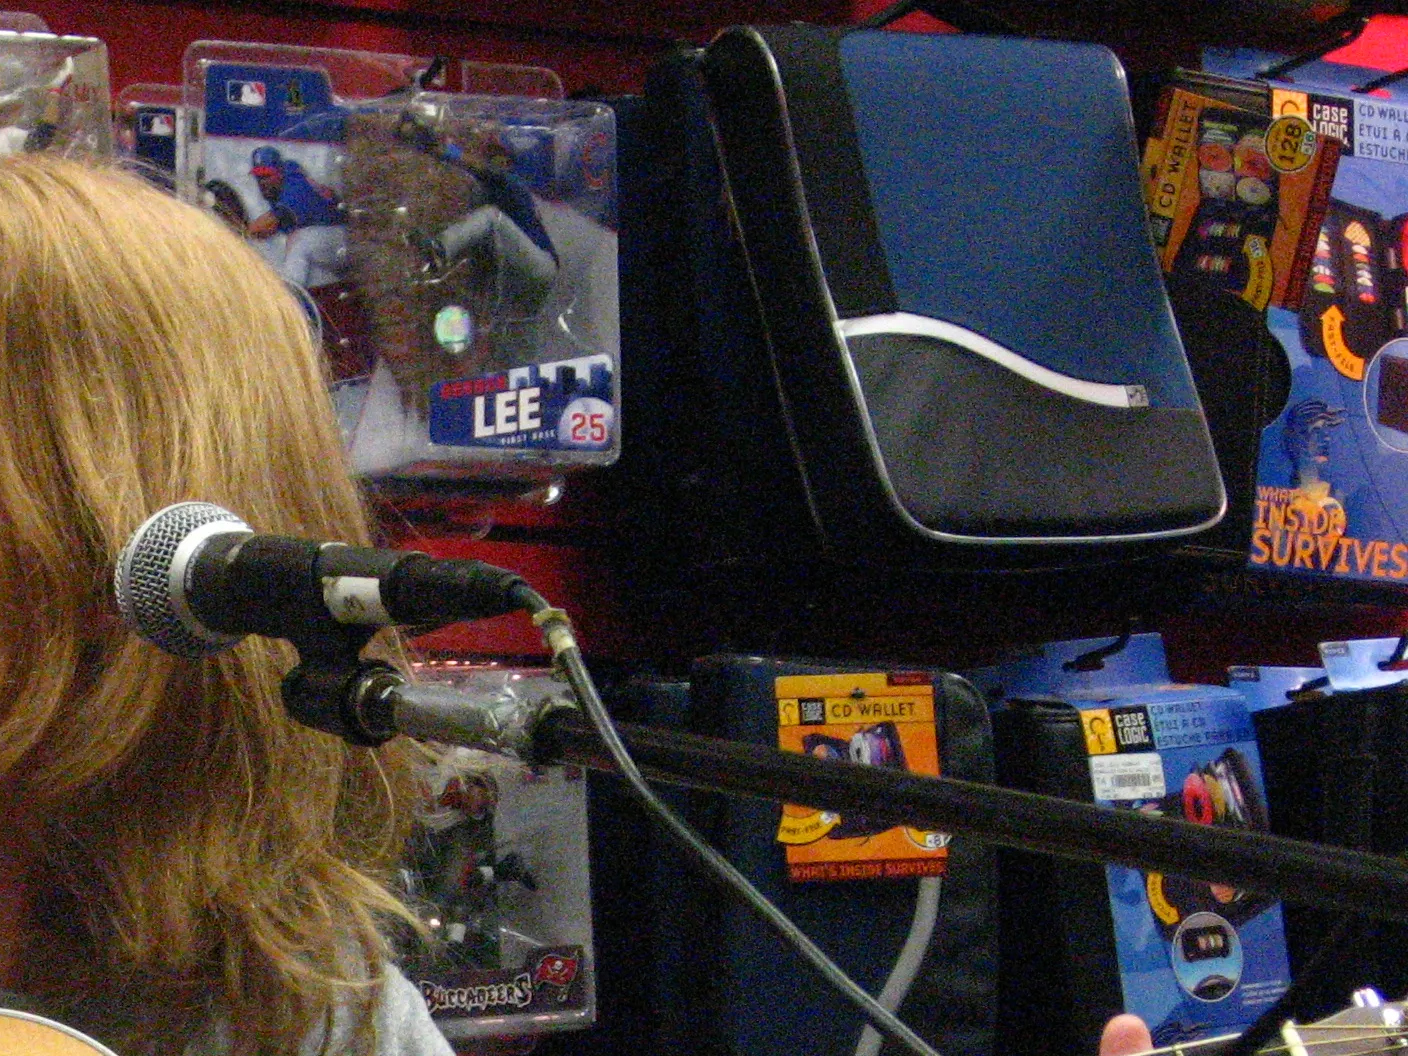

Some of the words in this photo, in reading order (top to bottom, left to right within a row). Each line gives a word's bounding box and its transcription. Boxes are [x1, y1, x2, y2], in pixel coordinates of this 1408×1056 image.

[1359, 103, 1375, 117] CD
[473, 387, 541, 439] LEE
[570, 412, 608, 443] 25
[1250, 528, 1408, 579] SURVIVES
[831, 703, 852, 718] CD
[859, 702, 915, 717] WALLET
[1115, 712, 1146, 727] case
[1119, 725, 1149, 745] LOGIC
[839, 863, 883, 878] INSIDE
[885, 860, 947, 877] SURVIVES
